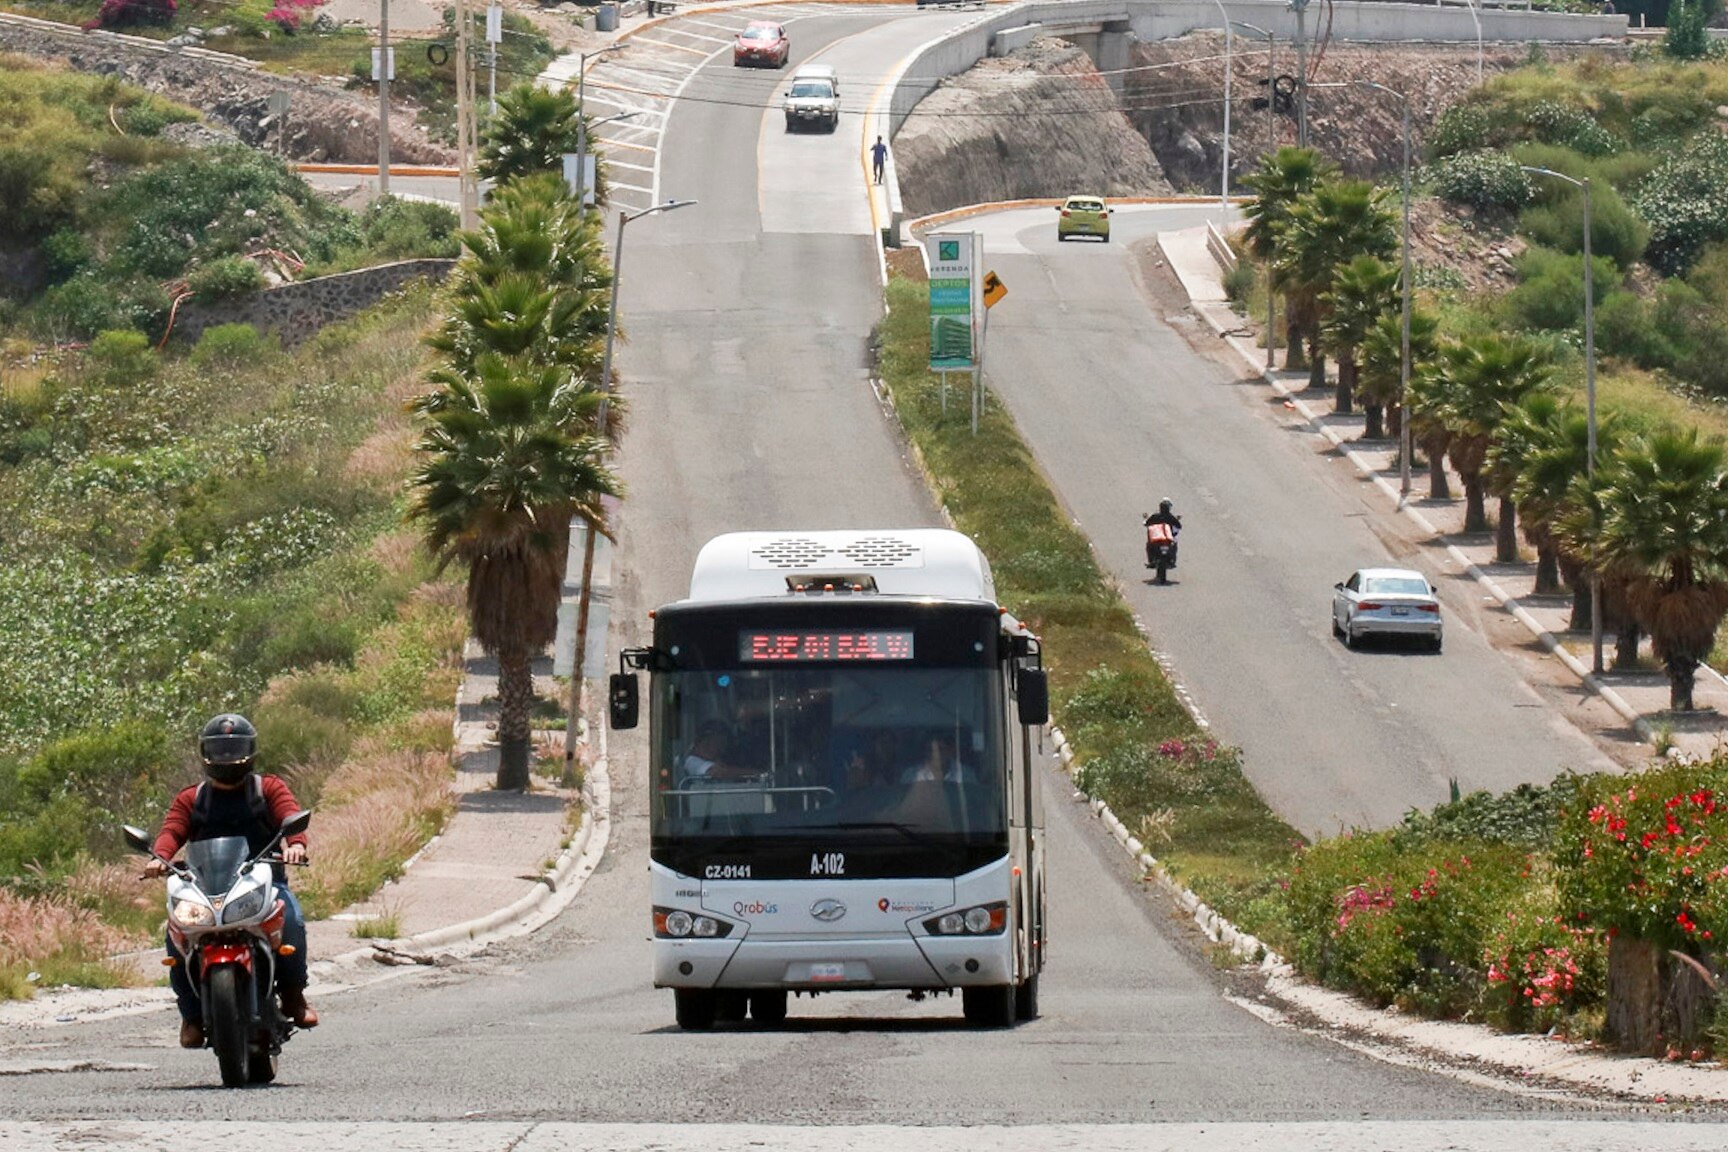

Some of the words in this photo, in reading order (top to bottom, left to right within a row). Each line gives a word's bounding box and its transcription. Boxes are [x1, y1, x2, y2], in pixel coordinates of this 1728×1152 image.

[752, 636, 799, 659] EJE
[705, 865, 751, 879] CZ-0141
[810, 852, 845, 875] A-102
